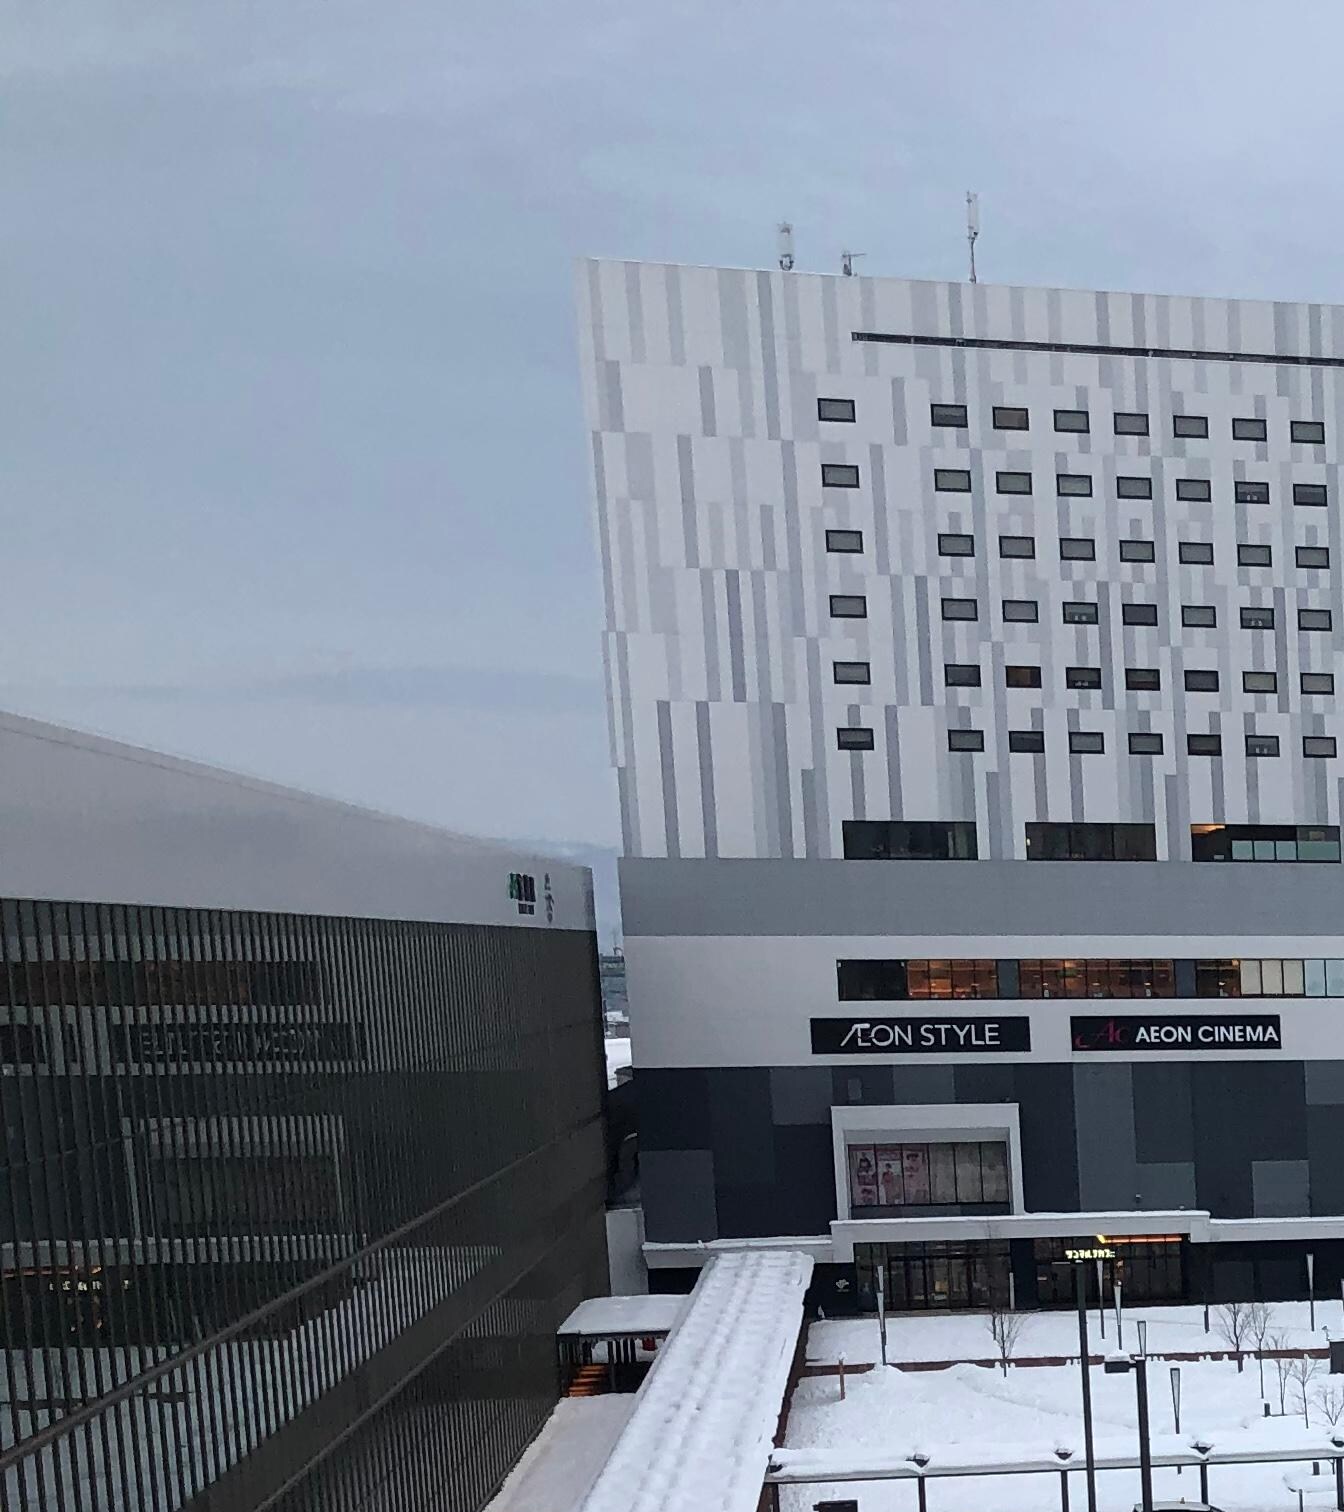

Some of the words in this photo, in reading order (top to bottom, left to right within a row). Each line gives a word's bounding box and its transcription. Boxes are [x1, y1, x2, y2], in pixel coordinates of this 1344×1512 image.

[920, 1023, 1001, 1046] STYLE
[1135, 1025, 1192, 1043] AEON
[1197, 1024, 1279, 1042] CINEMA
